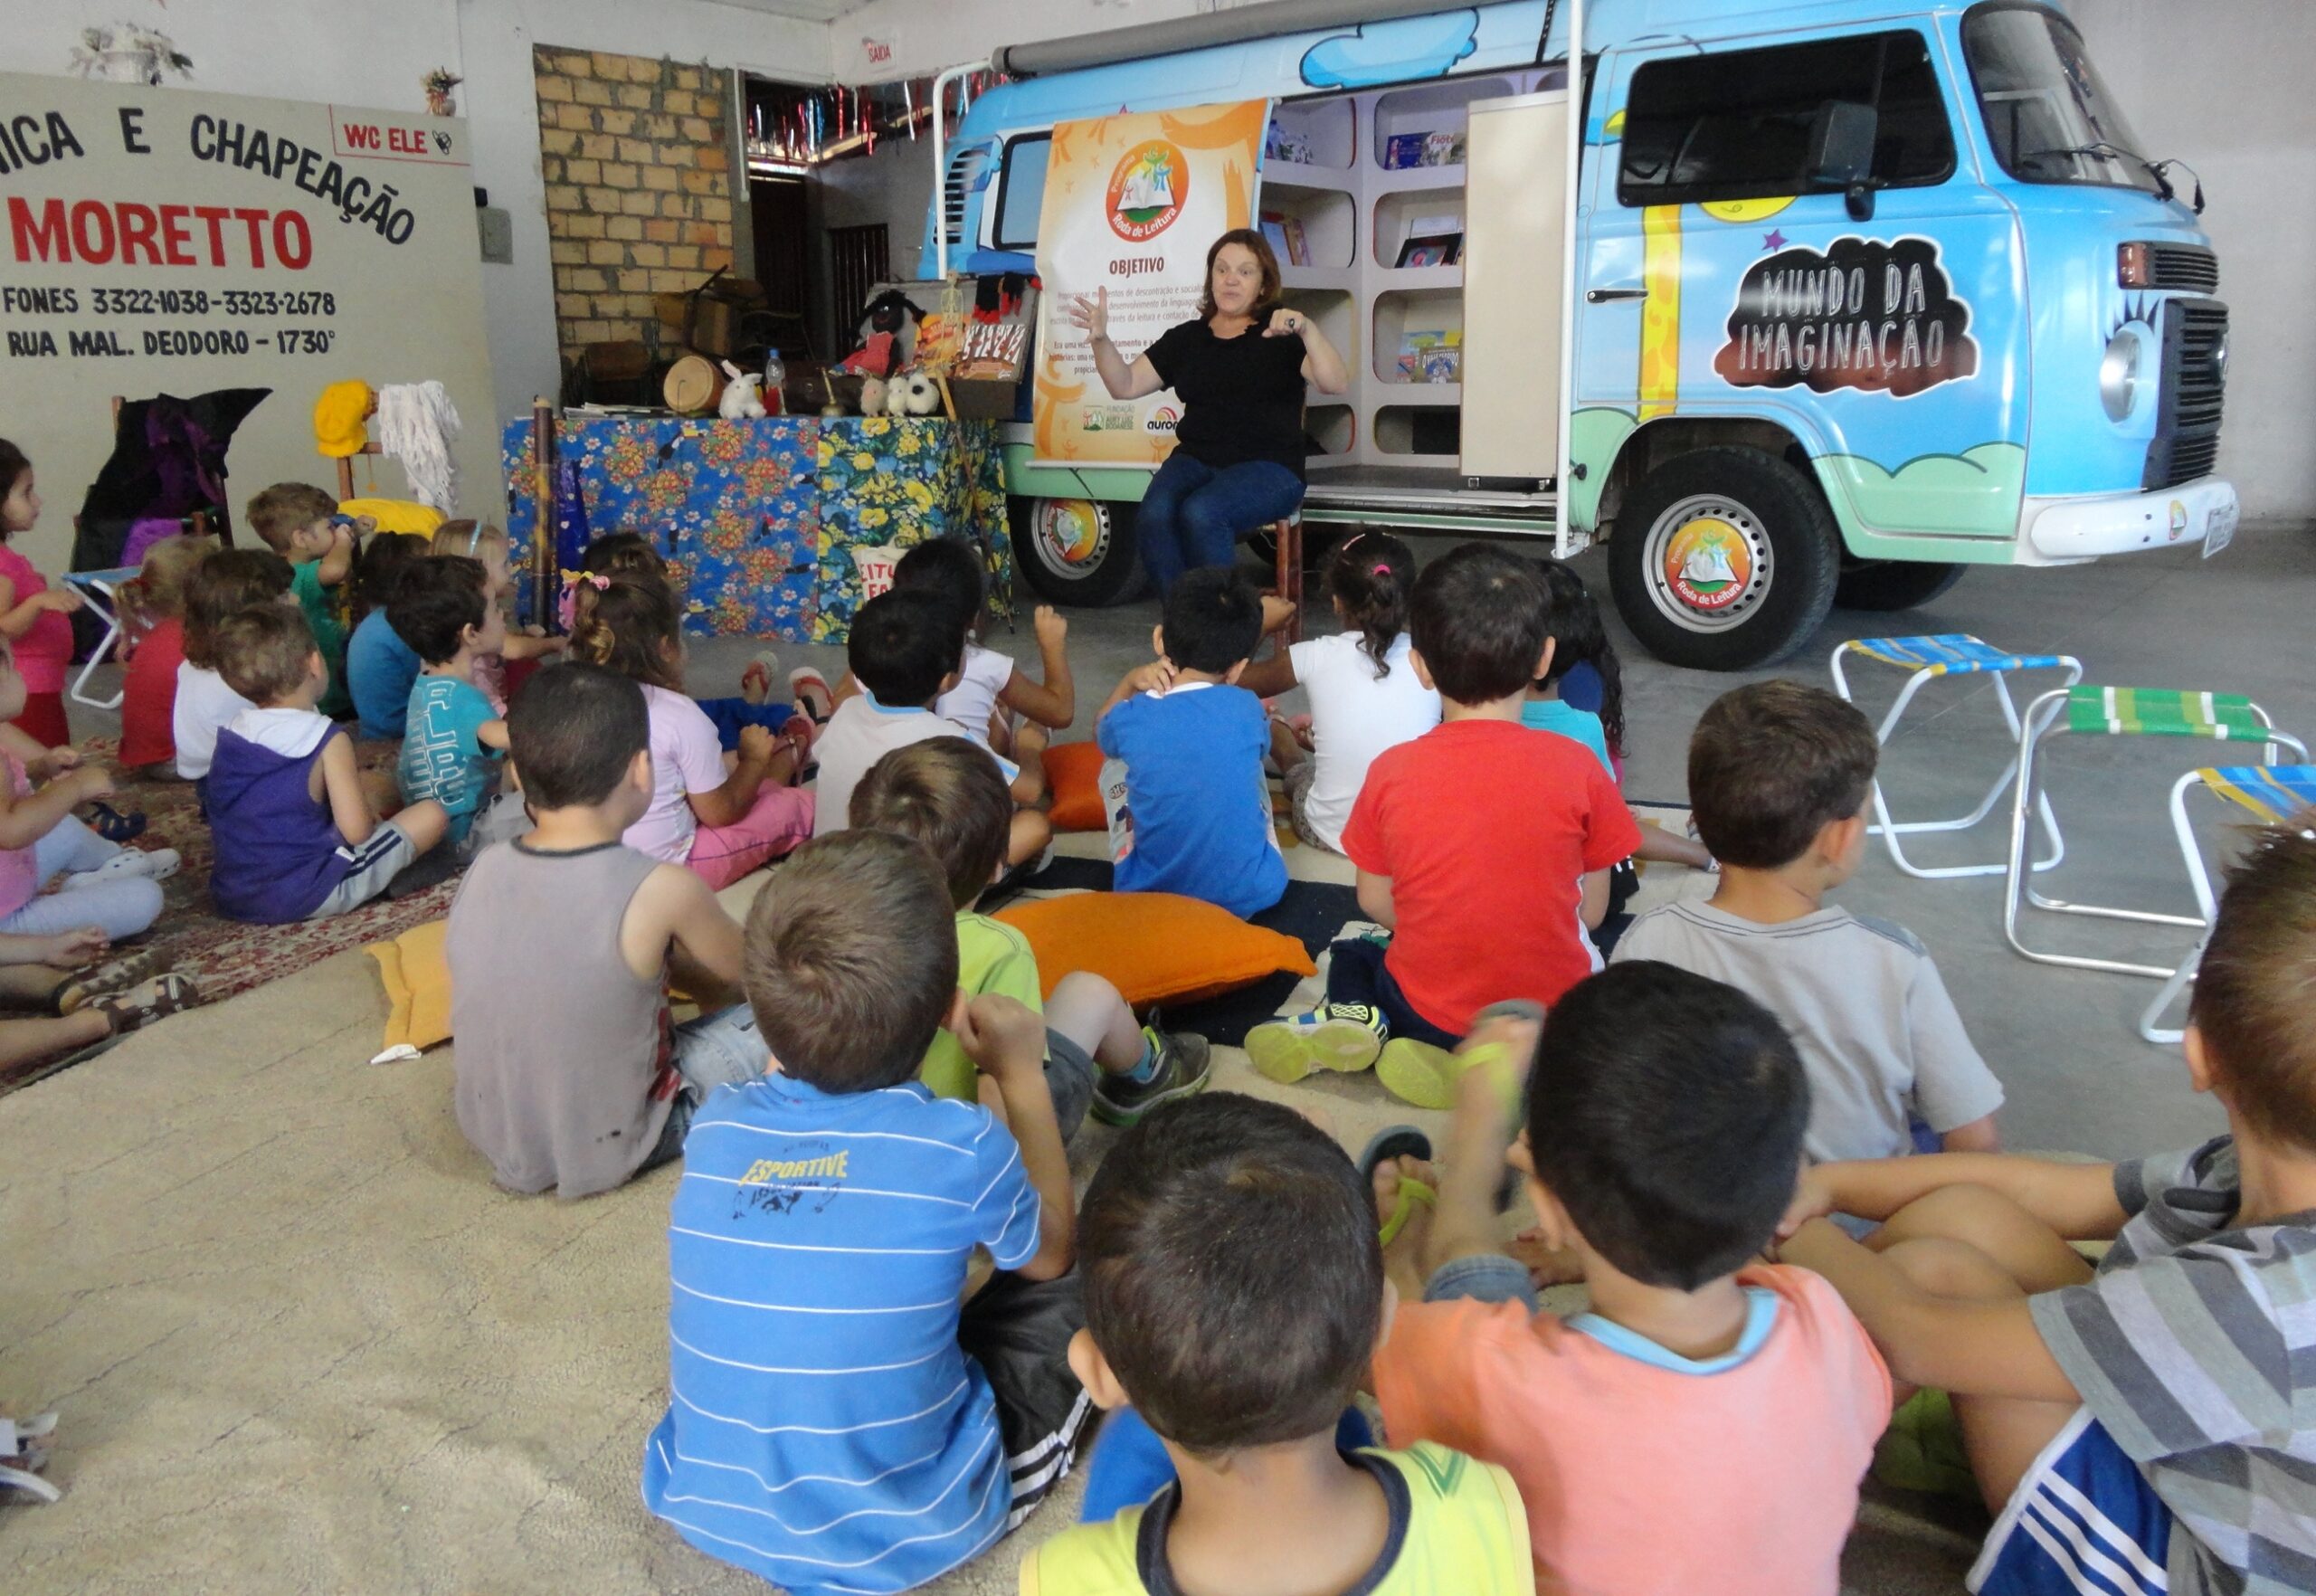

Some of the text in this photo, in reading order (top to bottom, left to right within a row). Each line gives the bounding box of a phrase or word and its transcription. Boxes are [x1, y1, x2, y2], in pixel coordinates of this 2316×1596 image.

[343, 123, 428, 154] WC ELE
[0, 107, 414, 245] ICA E CHAPEAÇÃO
[7, 196, 312, 270] MORETTO
[1113, 207, 1178, 237] Roda de Leitura
[1109, 256, 1165, 279] OBJETIVO
[3, 287, 79, 313] FONES
[1762, 262, 1925, 318] MUNDO DA
[7, 330, 58, 356] RUA
[69, 330, 134, 356] MAL.
[143, 329, 249, 356] DEODORO
[1147, 421, 1178, 431] auror
[1676, 581, 1742, 605] Roda de Leitura
[738, 1149, 849, 1187] ESPORTIVE
